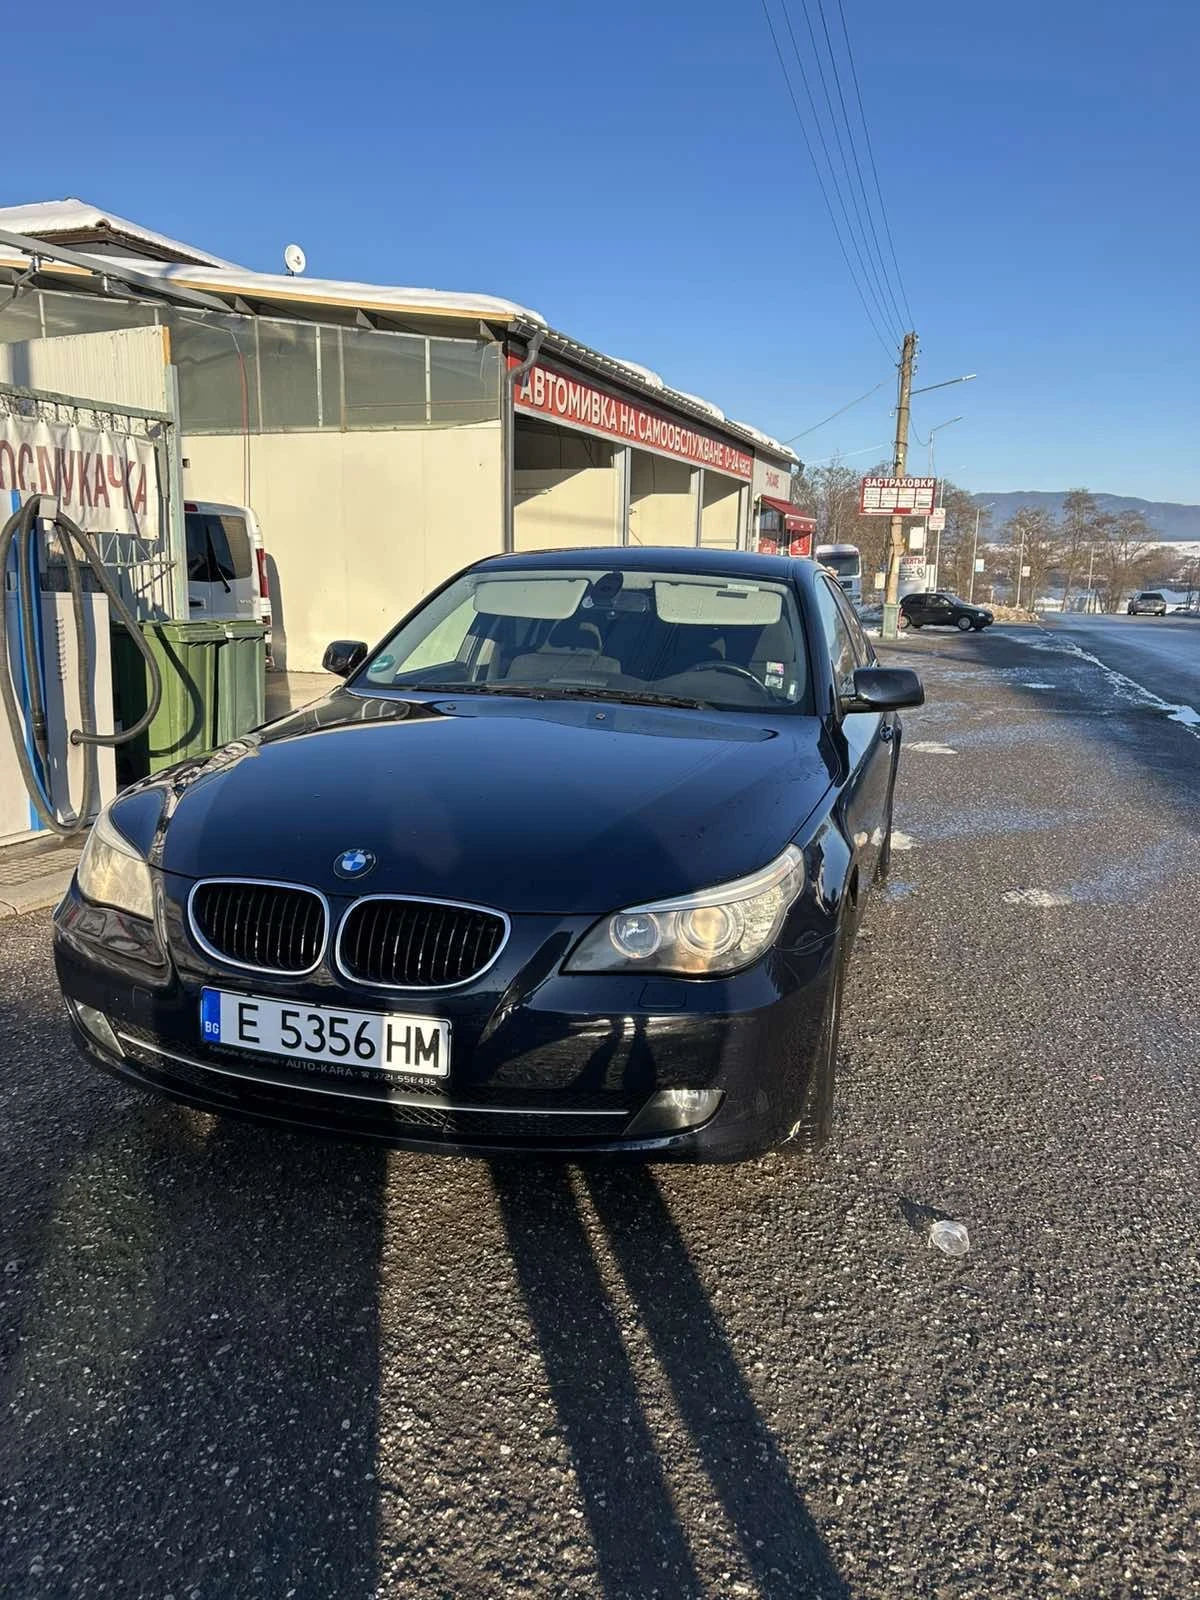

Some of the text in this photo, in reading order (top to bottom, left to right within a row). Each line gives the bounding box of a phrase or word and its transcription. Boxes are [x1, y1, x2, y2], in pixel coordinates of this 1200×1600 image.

[520, 366, 618, 431] АВТОМИВКА
[621, 403, 636, 436] НА
[639, 412, 722, 466] САМООБСЛУЖВАНЕ
[865, 478, 934, 488] ЗАСТРАХОВКИ
[205, 1021, 219, 1034] BG
[238, 1002, 260, 1044] E
[281, 1009, 376, 1060] 5356
[386, 1024, 440, 1068] HM
[286, 1059, 353, 1077] AUTO-KARA
